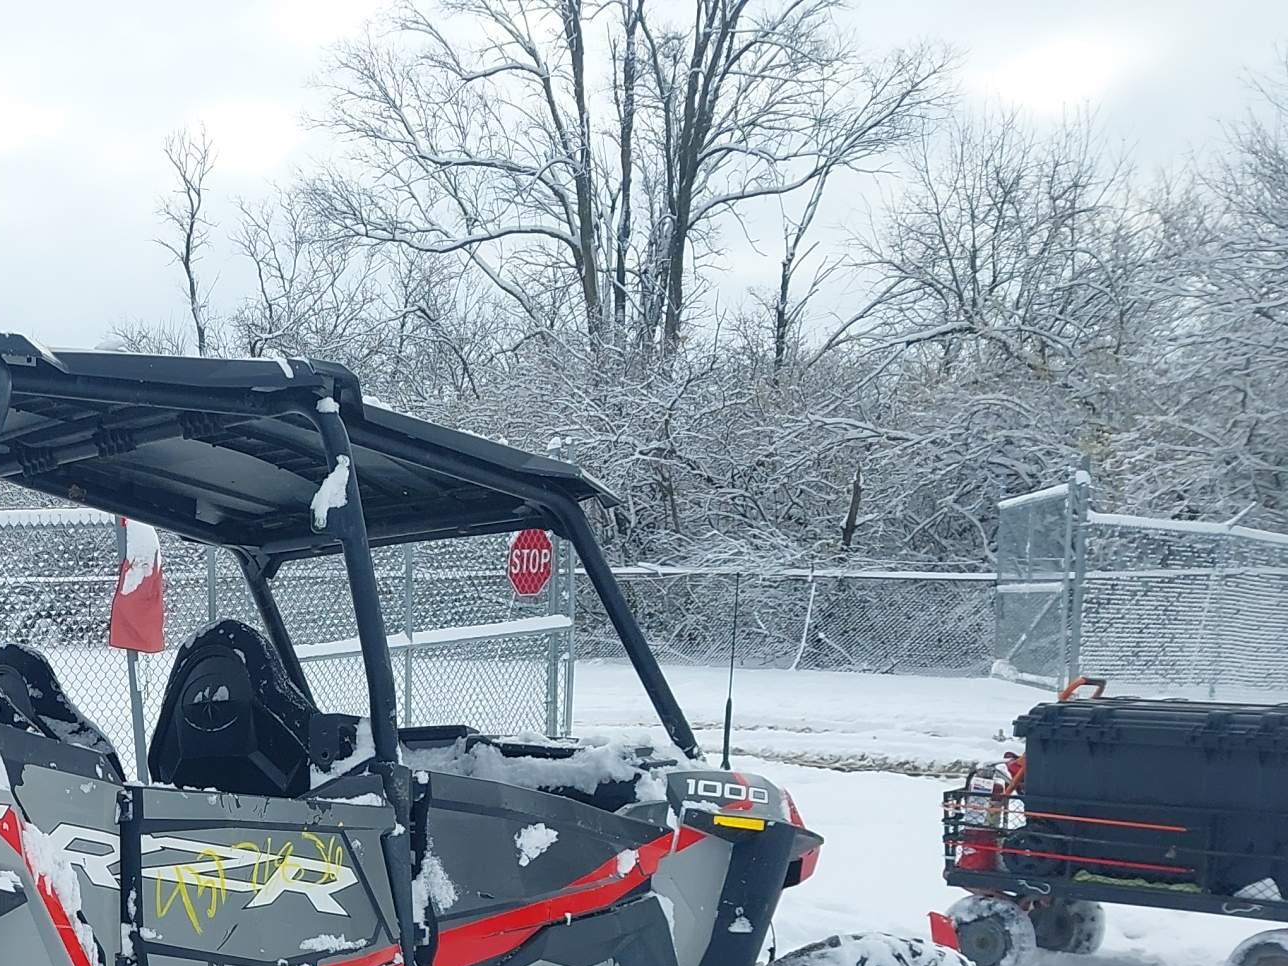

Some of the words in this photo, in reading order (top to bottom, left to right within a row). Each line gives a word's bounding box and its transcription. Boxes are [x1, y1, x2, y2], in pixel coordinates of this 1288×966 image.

[511, 548, 551, 574] STOP
[686, 778, 769, 804] 1000
[47, 821, 360, 918] RZR
